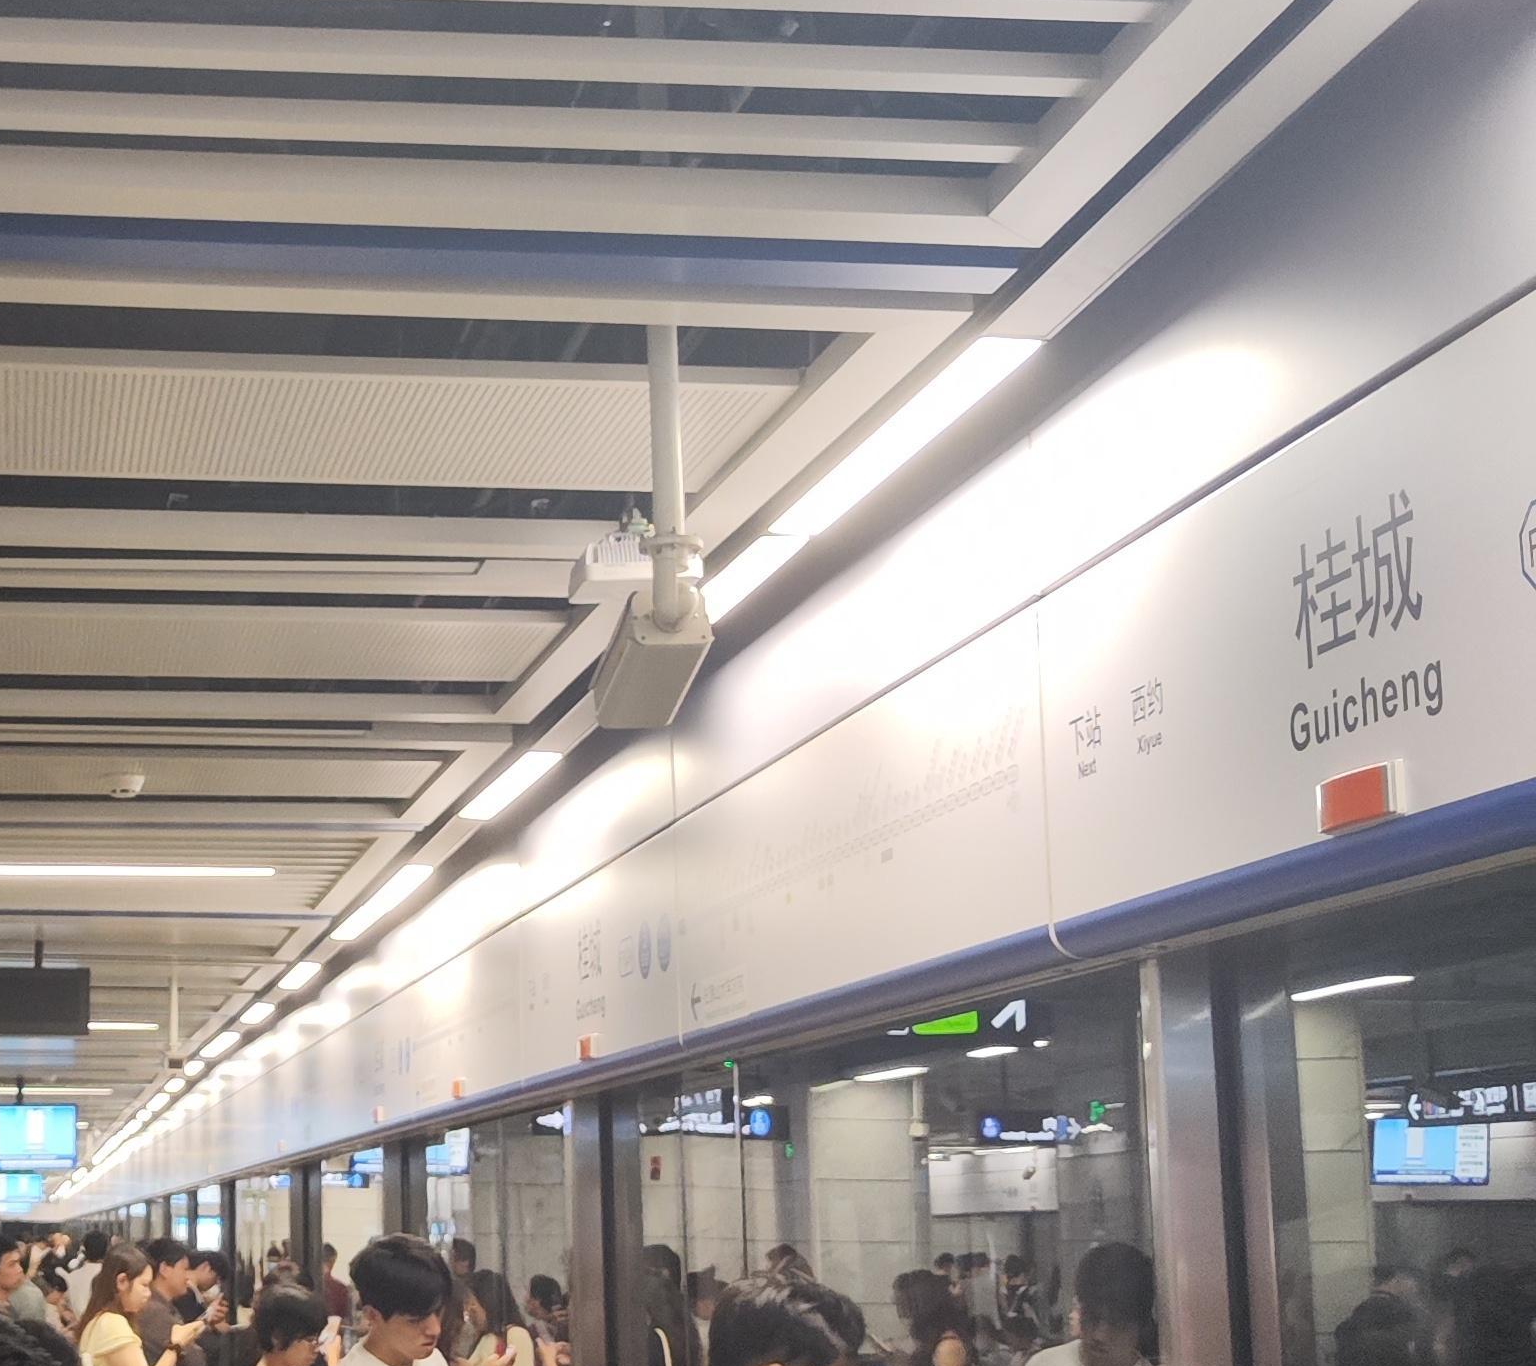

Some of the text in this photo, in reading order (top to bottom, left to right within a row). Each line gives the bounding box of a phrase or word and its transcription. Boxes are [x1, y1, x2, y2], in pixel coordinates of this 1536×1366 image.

[1292, 488, 1423, 669] 桂城
[1069, 676, 1163, 755] 下站 西约
[1290, 659, 1443, 752] Guicheng
[1077, 732, 1163, 780] Next Xiyue
